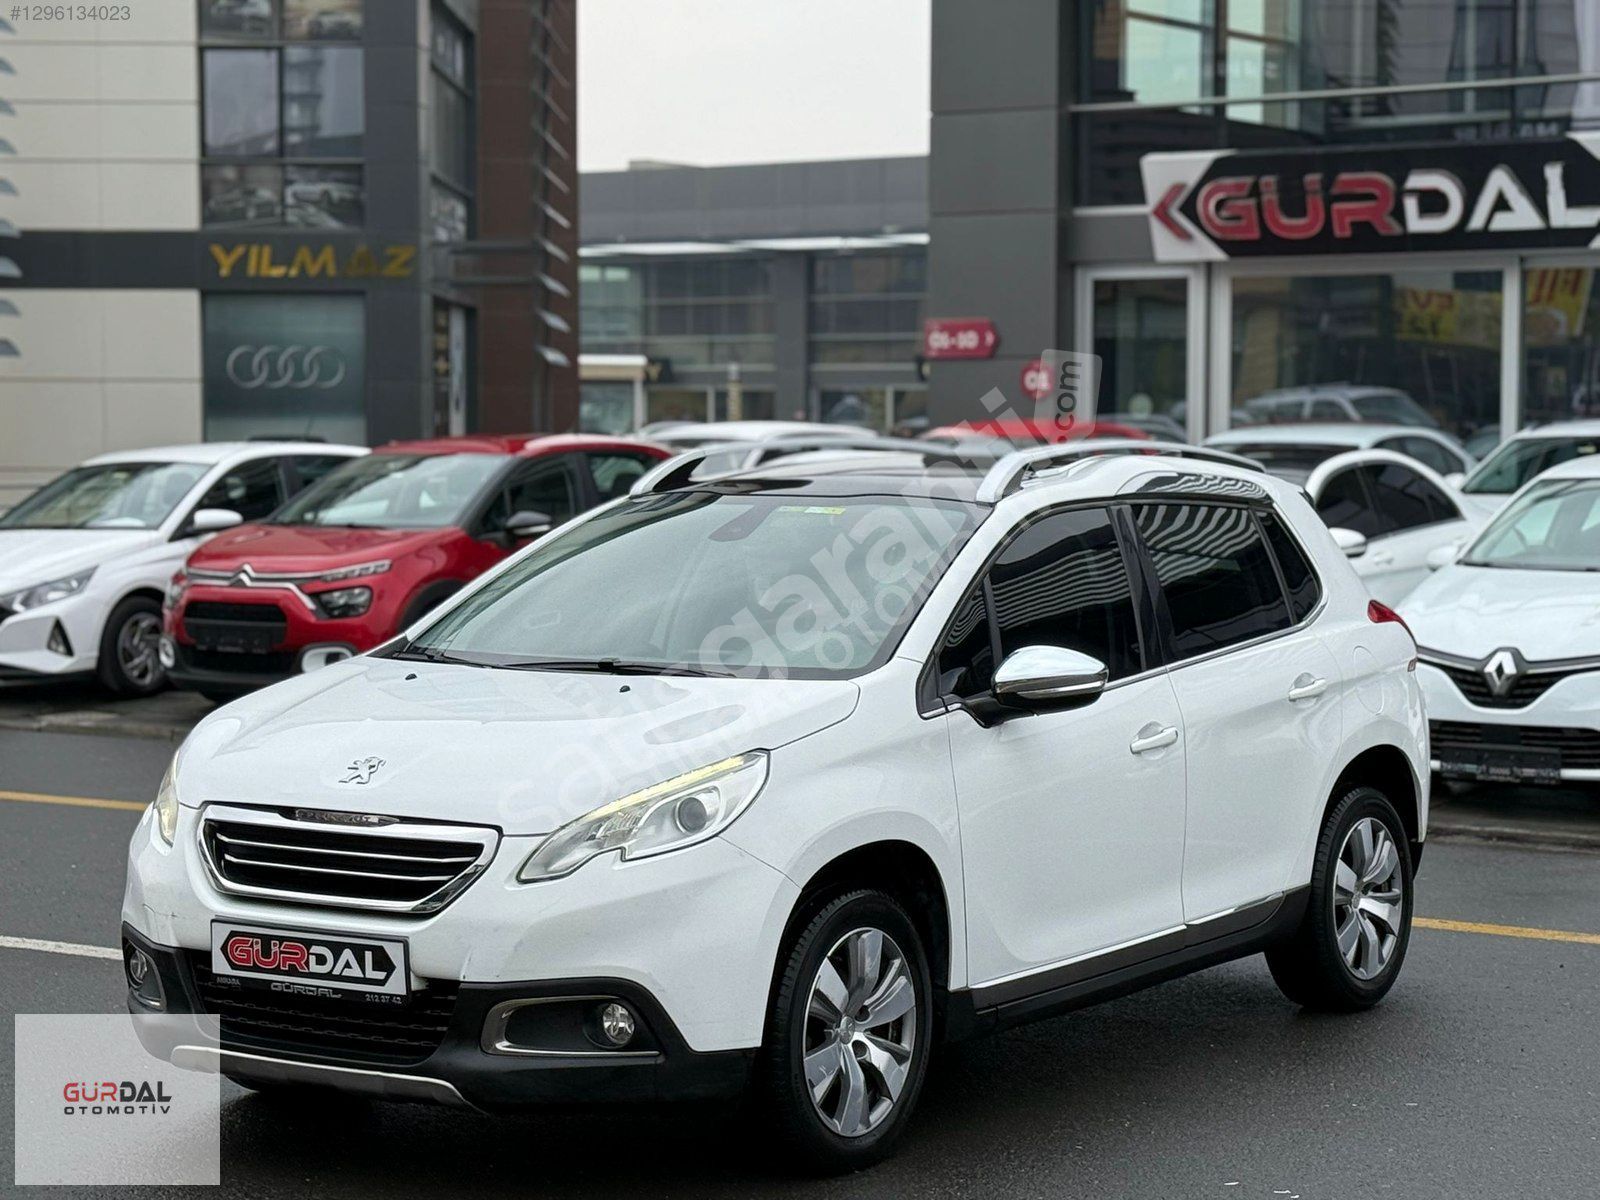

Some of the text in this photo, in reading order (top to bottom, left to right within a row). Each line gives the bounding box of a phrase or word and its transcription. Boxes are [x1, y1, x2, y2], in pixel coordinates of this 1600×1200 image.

[1196, 160, 1600, 241] GÜRDAL
[209, 244, 416, 278] YILMAZ
[227, 935, 388, 980] GÜRDAL
